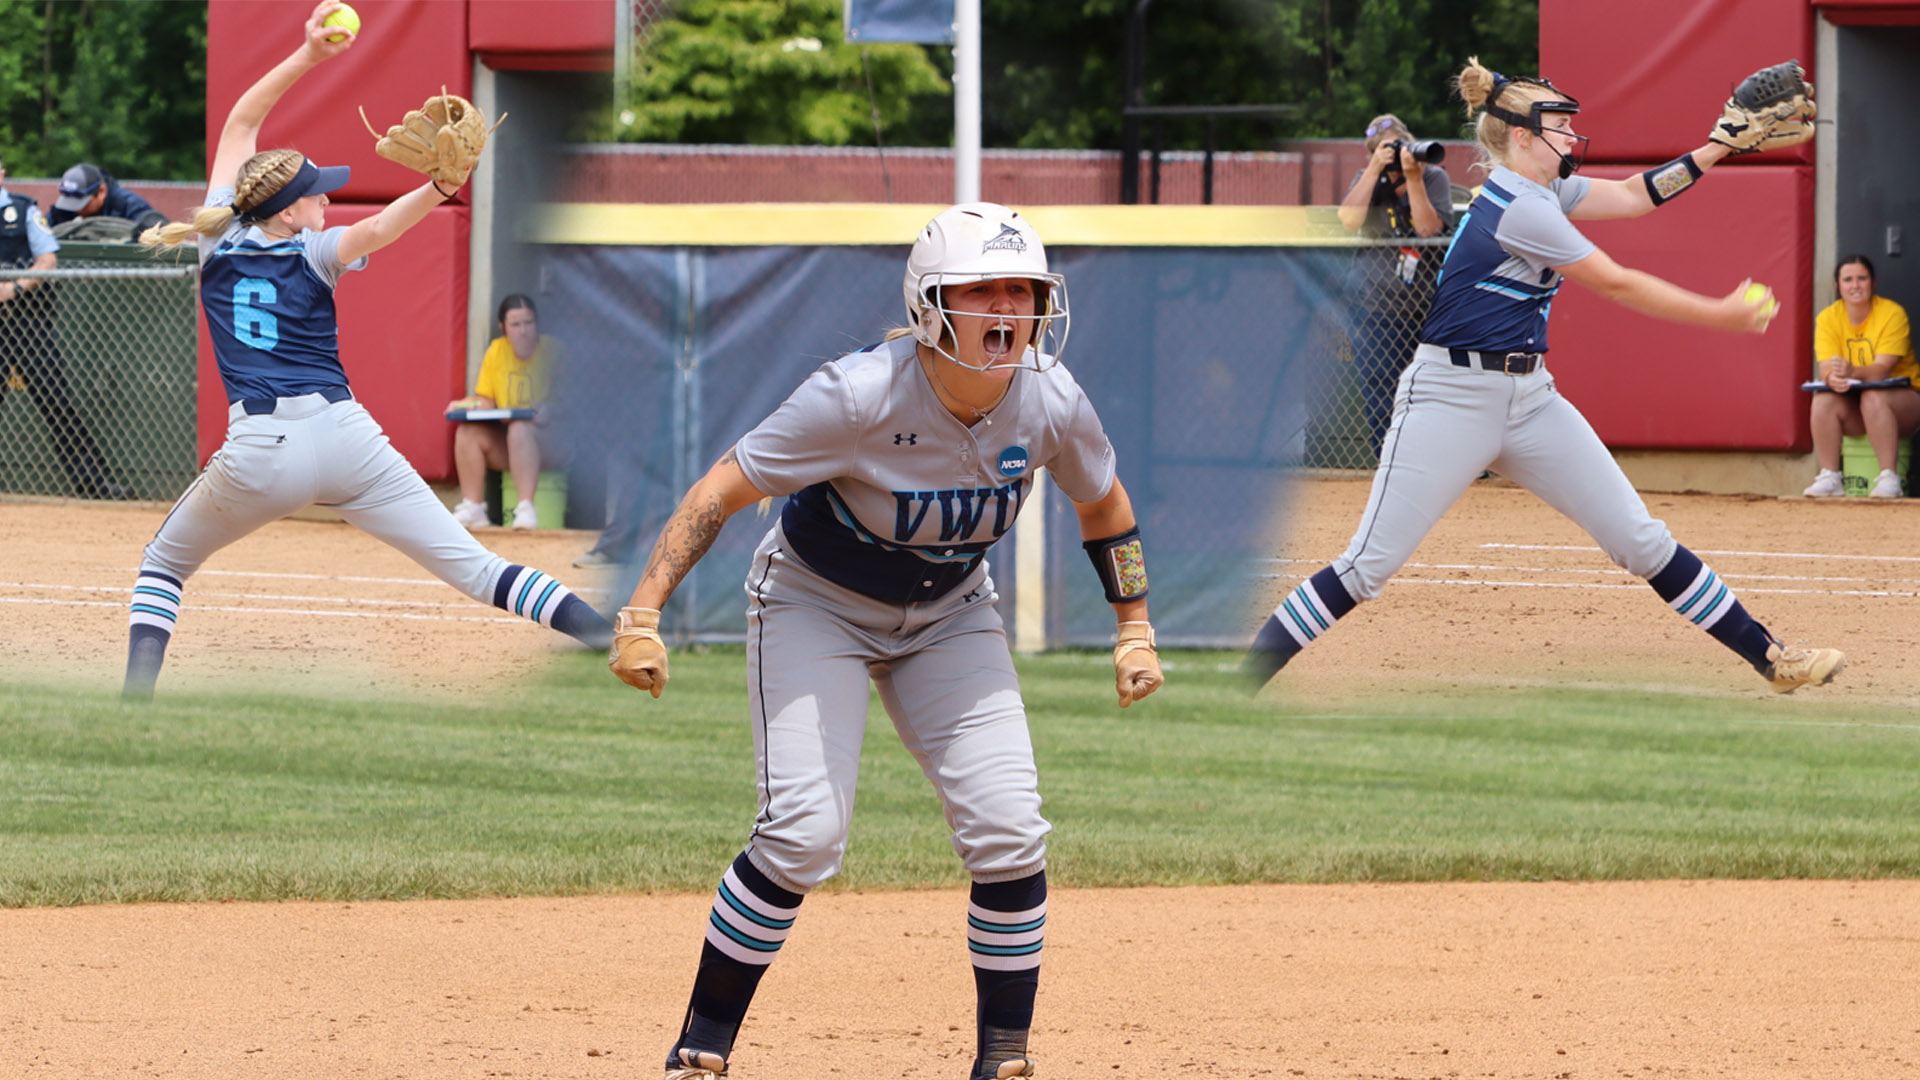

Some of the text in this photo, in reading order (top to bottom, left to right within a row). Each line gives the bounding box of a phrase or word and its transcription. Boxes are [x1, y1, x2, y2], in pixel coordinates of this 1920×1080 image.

[233, 277, 279, 350] 6
[1001, 459, 1026, 469] NCAA
[891, 477, 1023, 542] VWU
